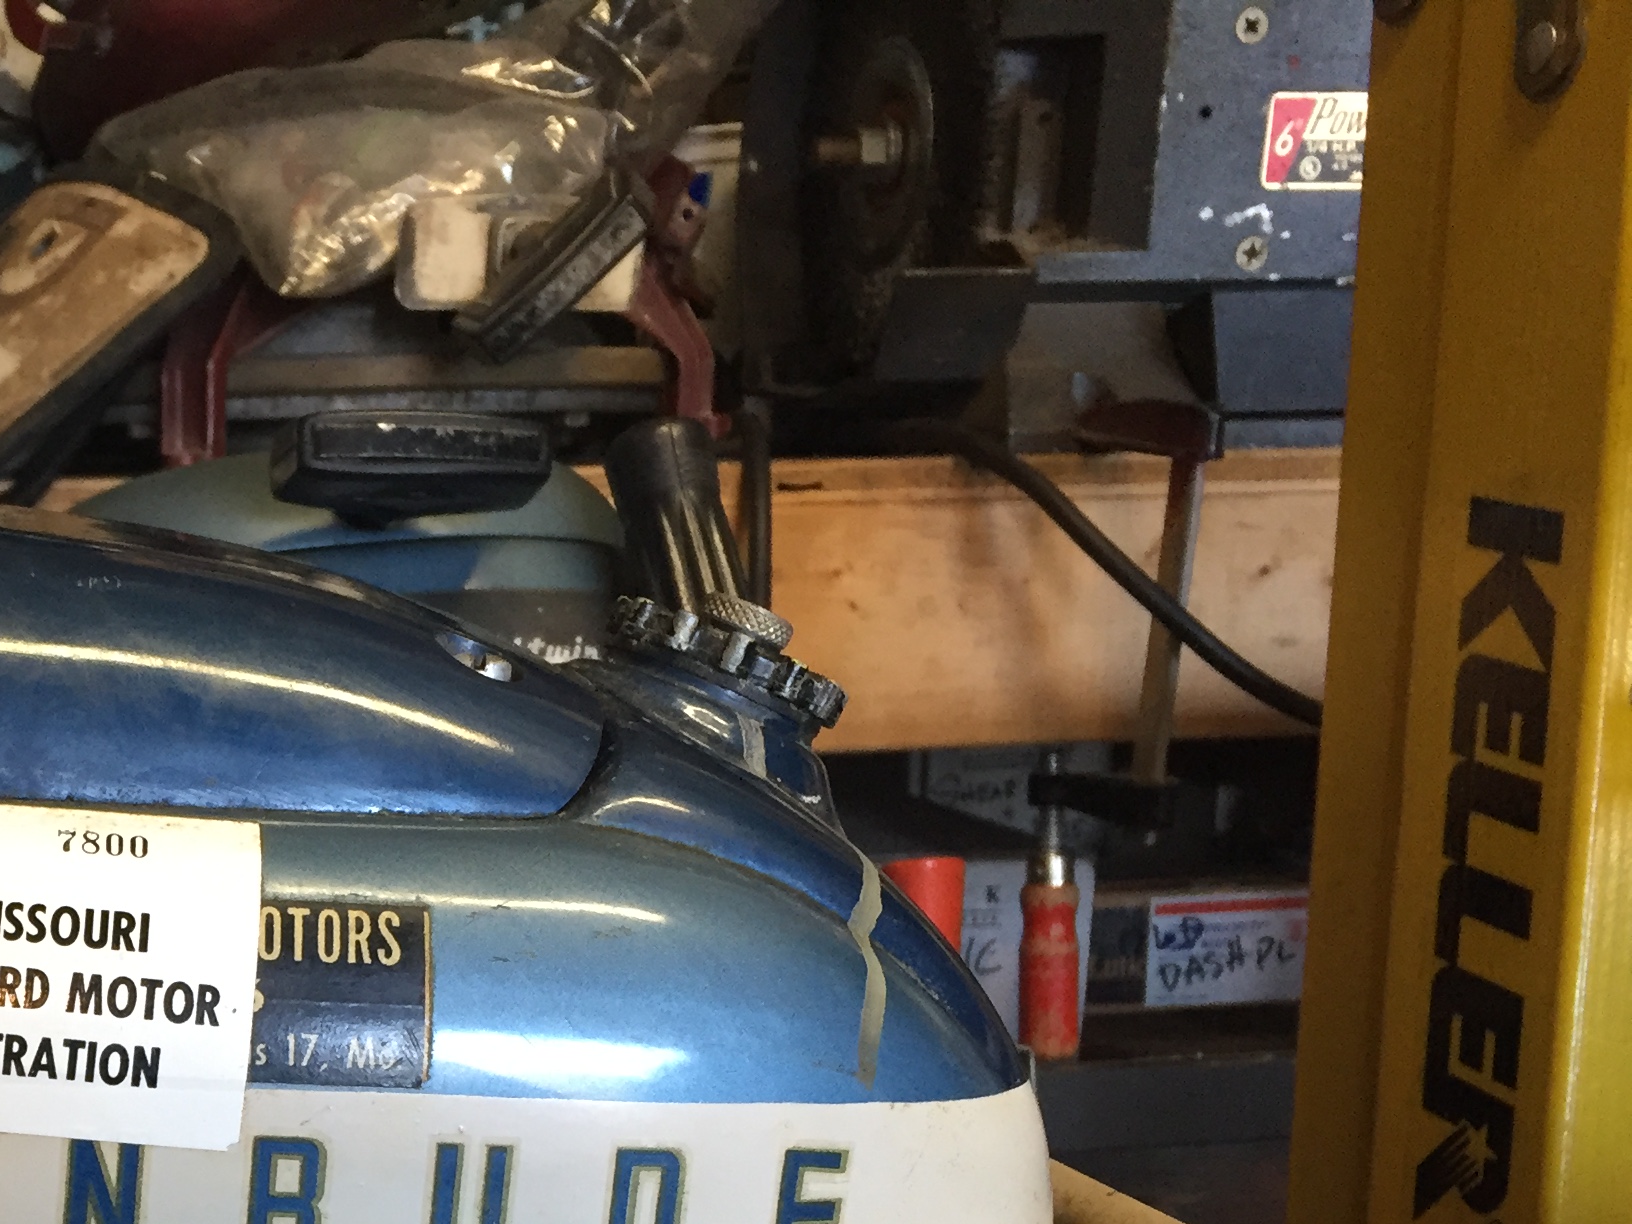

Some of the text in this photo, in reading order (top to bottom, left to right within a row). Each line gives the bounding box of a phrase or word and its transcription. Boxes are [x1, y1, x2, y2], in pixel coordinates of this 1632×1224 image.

[57, 829, 149, 858] 7800
[1411, 496, 1565, 1220] KELLER
[65, 971, 221, 1027] MOTOR
